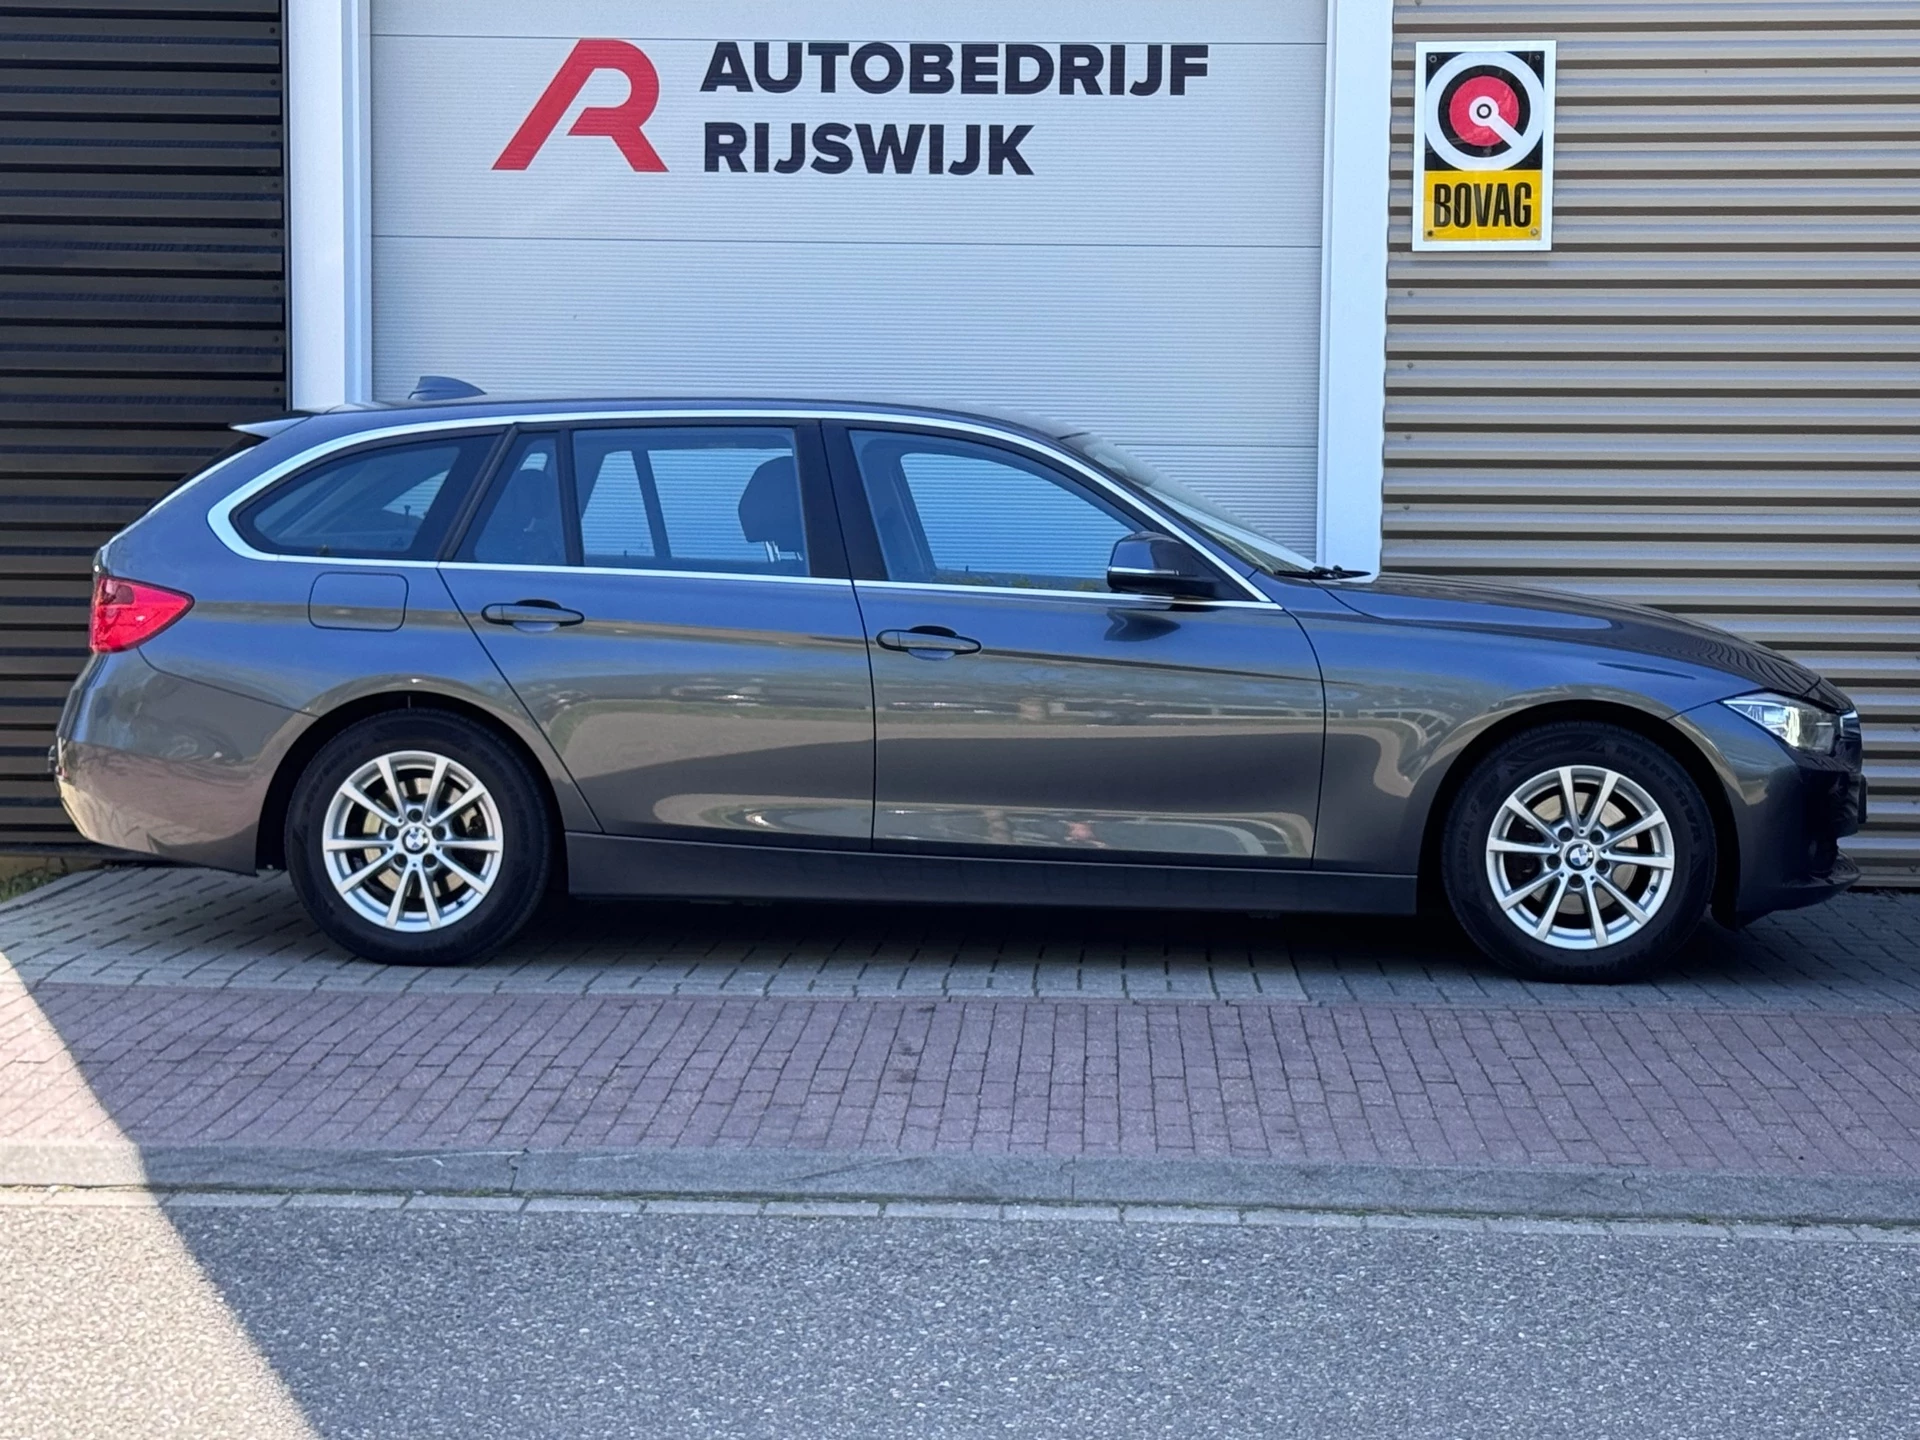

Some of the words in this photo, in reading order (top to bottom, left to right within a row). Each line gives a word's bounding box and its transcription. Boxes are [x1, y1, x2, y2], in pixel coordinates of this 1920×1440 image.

[701, 41, 1209, 97] AUTOBEDRIJF
[704, 122, 1034, 176] RIJSWIJK
[1433, 182, 1532, 229] BOVAG
